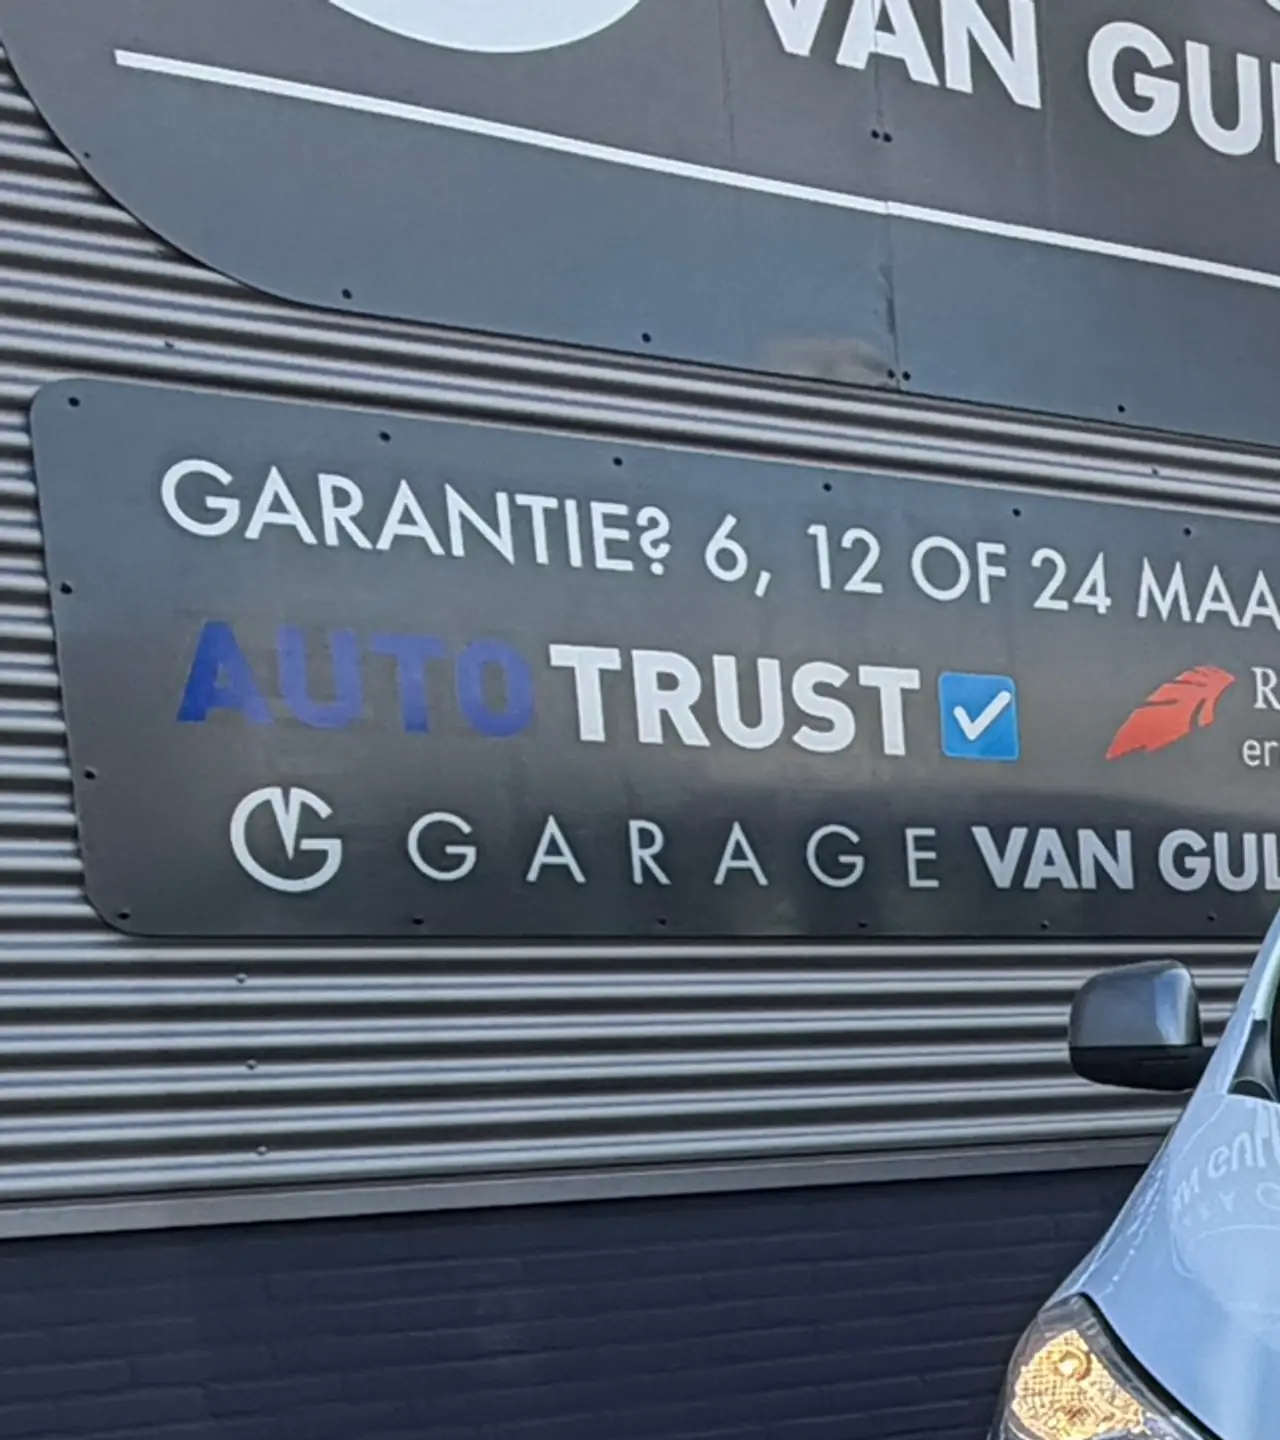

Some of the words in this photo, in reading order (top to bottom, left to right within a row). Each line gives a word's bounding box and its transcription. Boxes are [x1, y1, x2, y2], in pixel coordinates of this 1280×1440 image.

[764, 0, 1041, 109] VAN
[160, 458, 672, 575] GARANTIE?
[704, 513, 772, 597] 6,
[807, 524, 883, 594] 12
[911, 536, 1007, 603] OF
[1031, 548, 1112, 614] 24
[407, 811, 940, 887] GARAGE
[971, 826, 1134, 890] VAN
